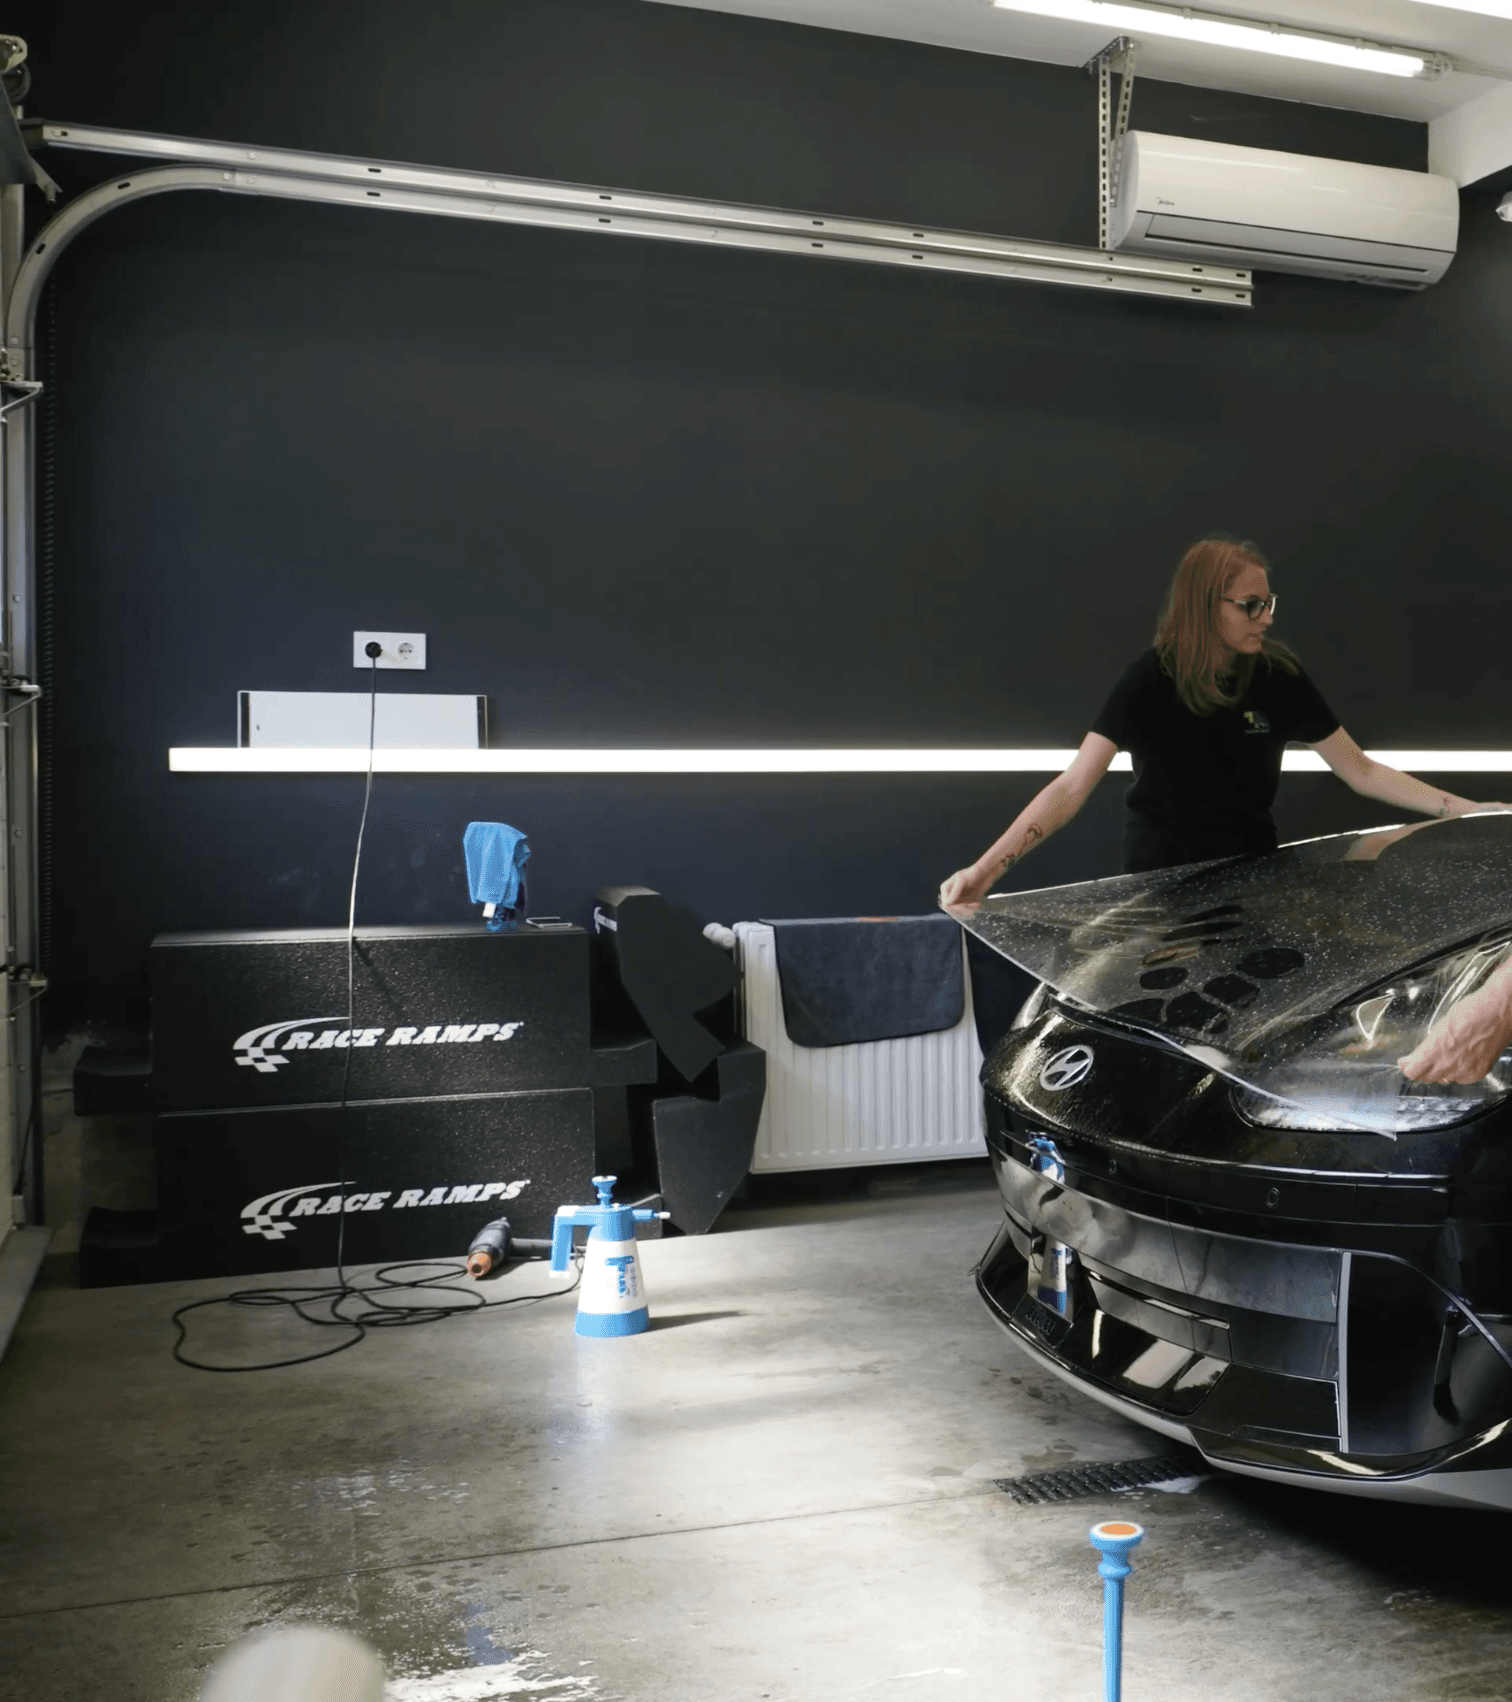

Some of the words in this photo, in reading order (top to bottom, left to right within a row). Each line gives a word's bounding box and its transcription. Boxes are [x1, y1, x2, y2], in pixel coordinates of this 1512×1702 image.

[281, 1027, 385, 1050] RACE
[386, 1023, 520, 1046] RAMPS
[289, 1191, 391, 1217] RACE
[392, 1180, 526, 1208] RAMPS
